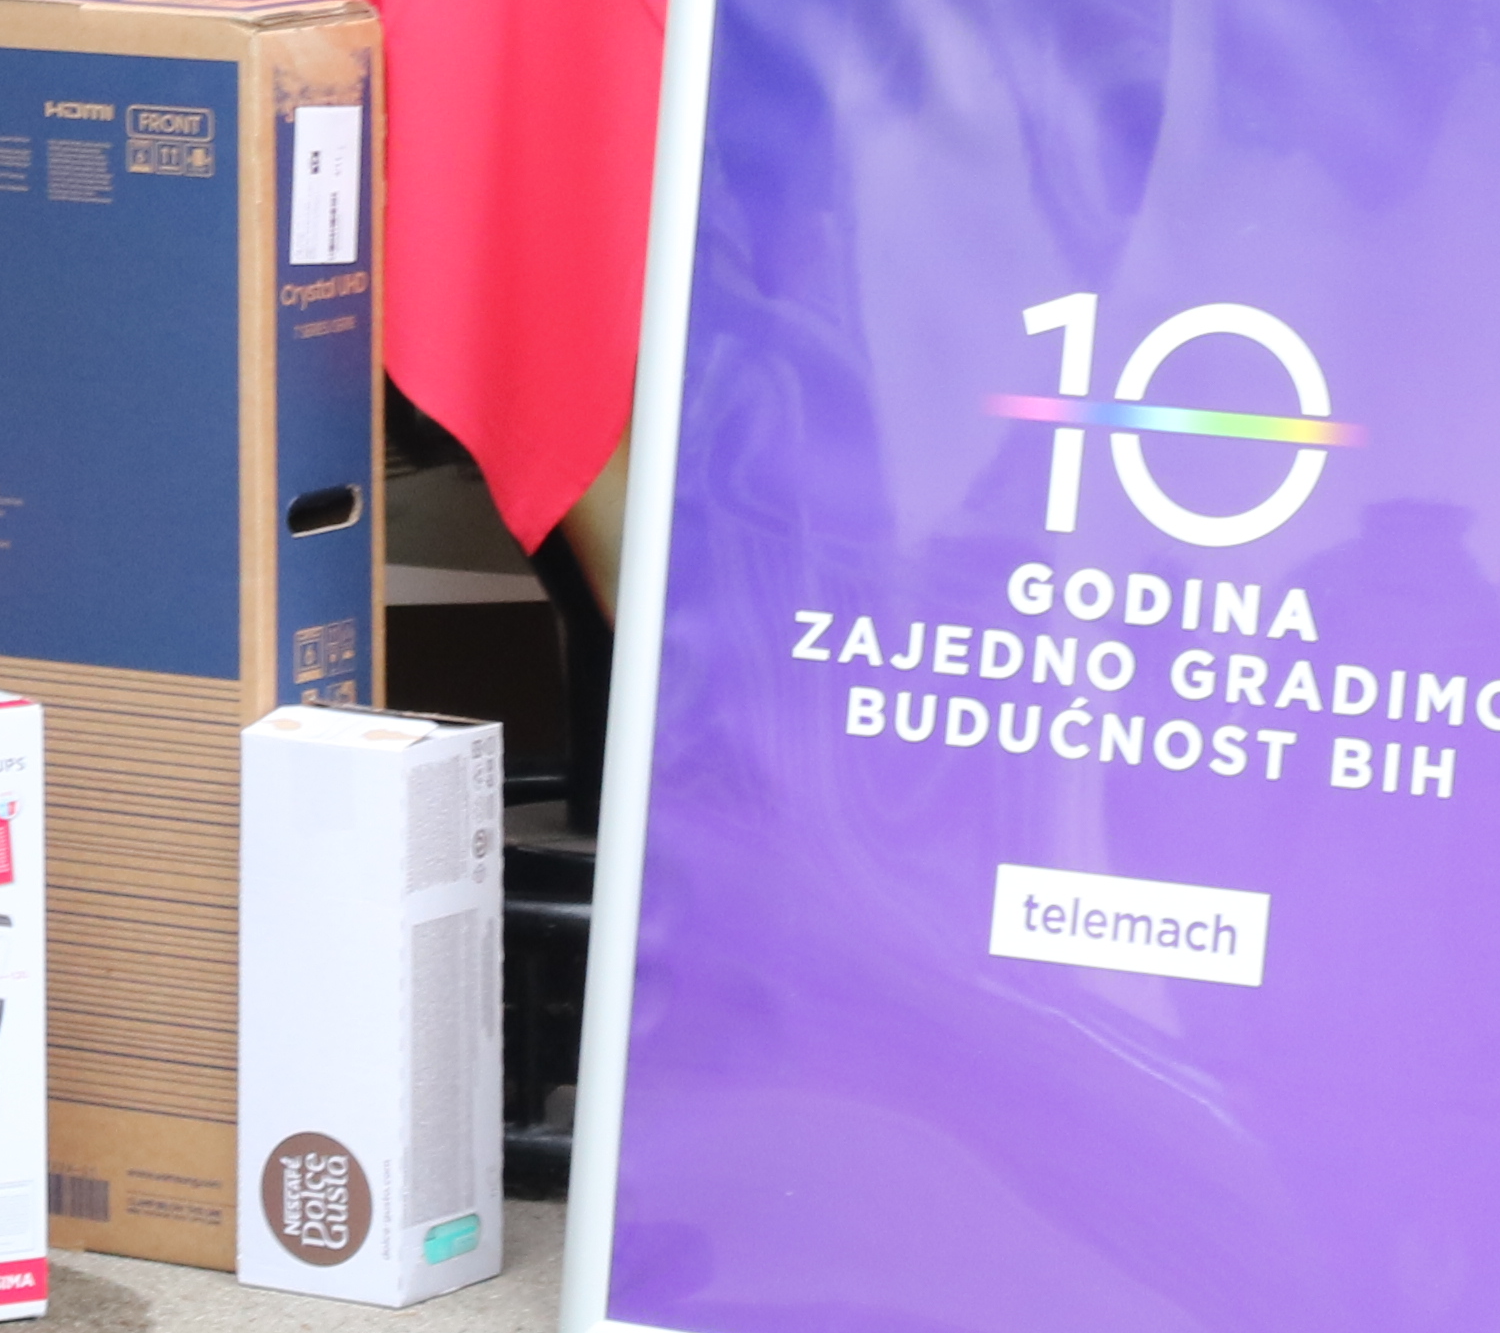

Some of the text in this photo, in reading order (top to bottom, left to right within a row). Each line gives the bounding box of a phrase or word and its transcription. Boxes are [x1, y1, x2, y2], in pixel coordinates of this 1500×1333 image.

[44, 101, 115, 121] HDMI
[138, 112, 202, 135] FRONT
[1023, 291, 1332, 548] 10
[1007, 563, 1319, 642] GODINA
[791, 610, 1137, 692] ZAJEDNO
[845, 687, 1457, 799] BUDUĆNOST BIH
[1023, 893, 1239, 956] telemach
[301, 1152, 328, 1248] Dolce
[324, 1153, 349, 1251] Gusto
